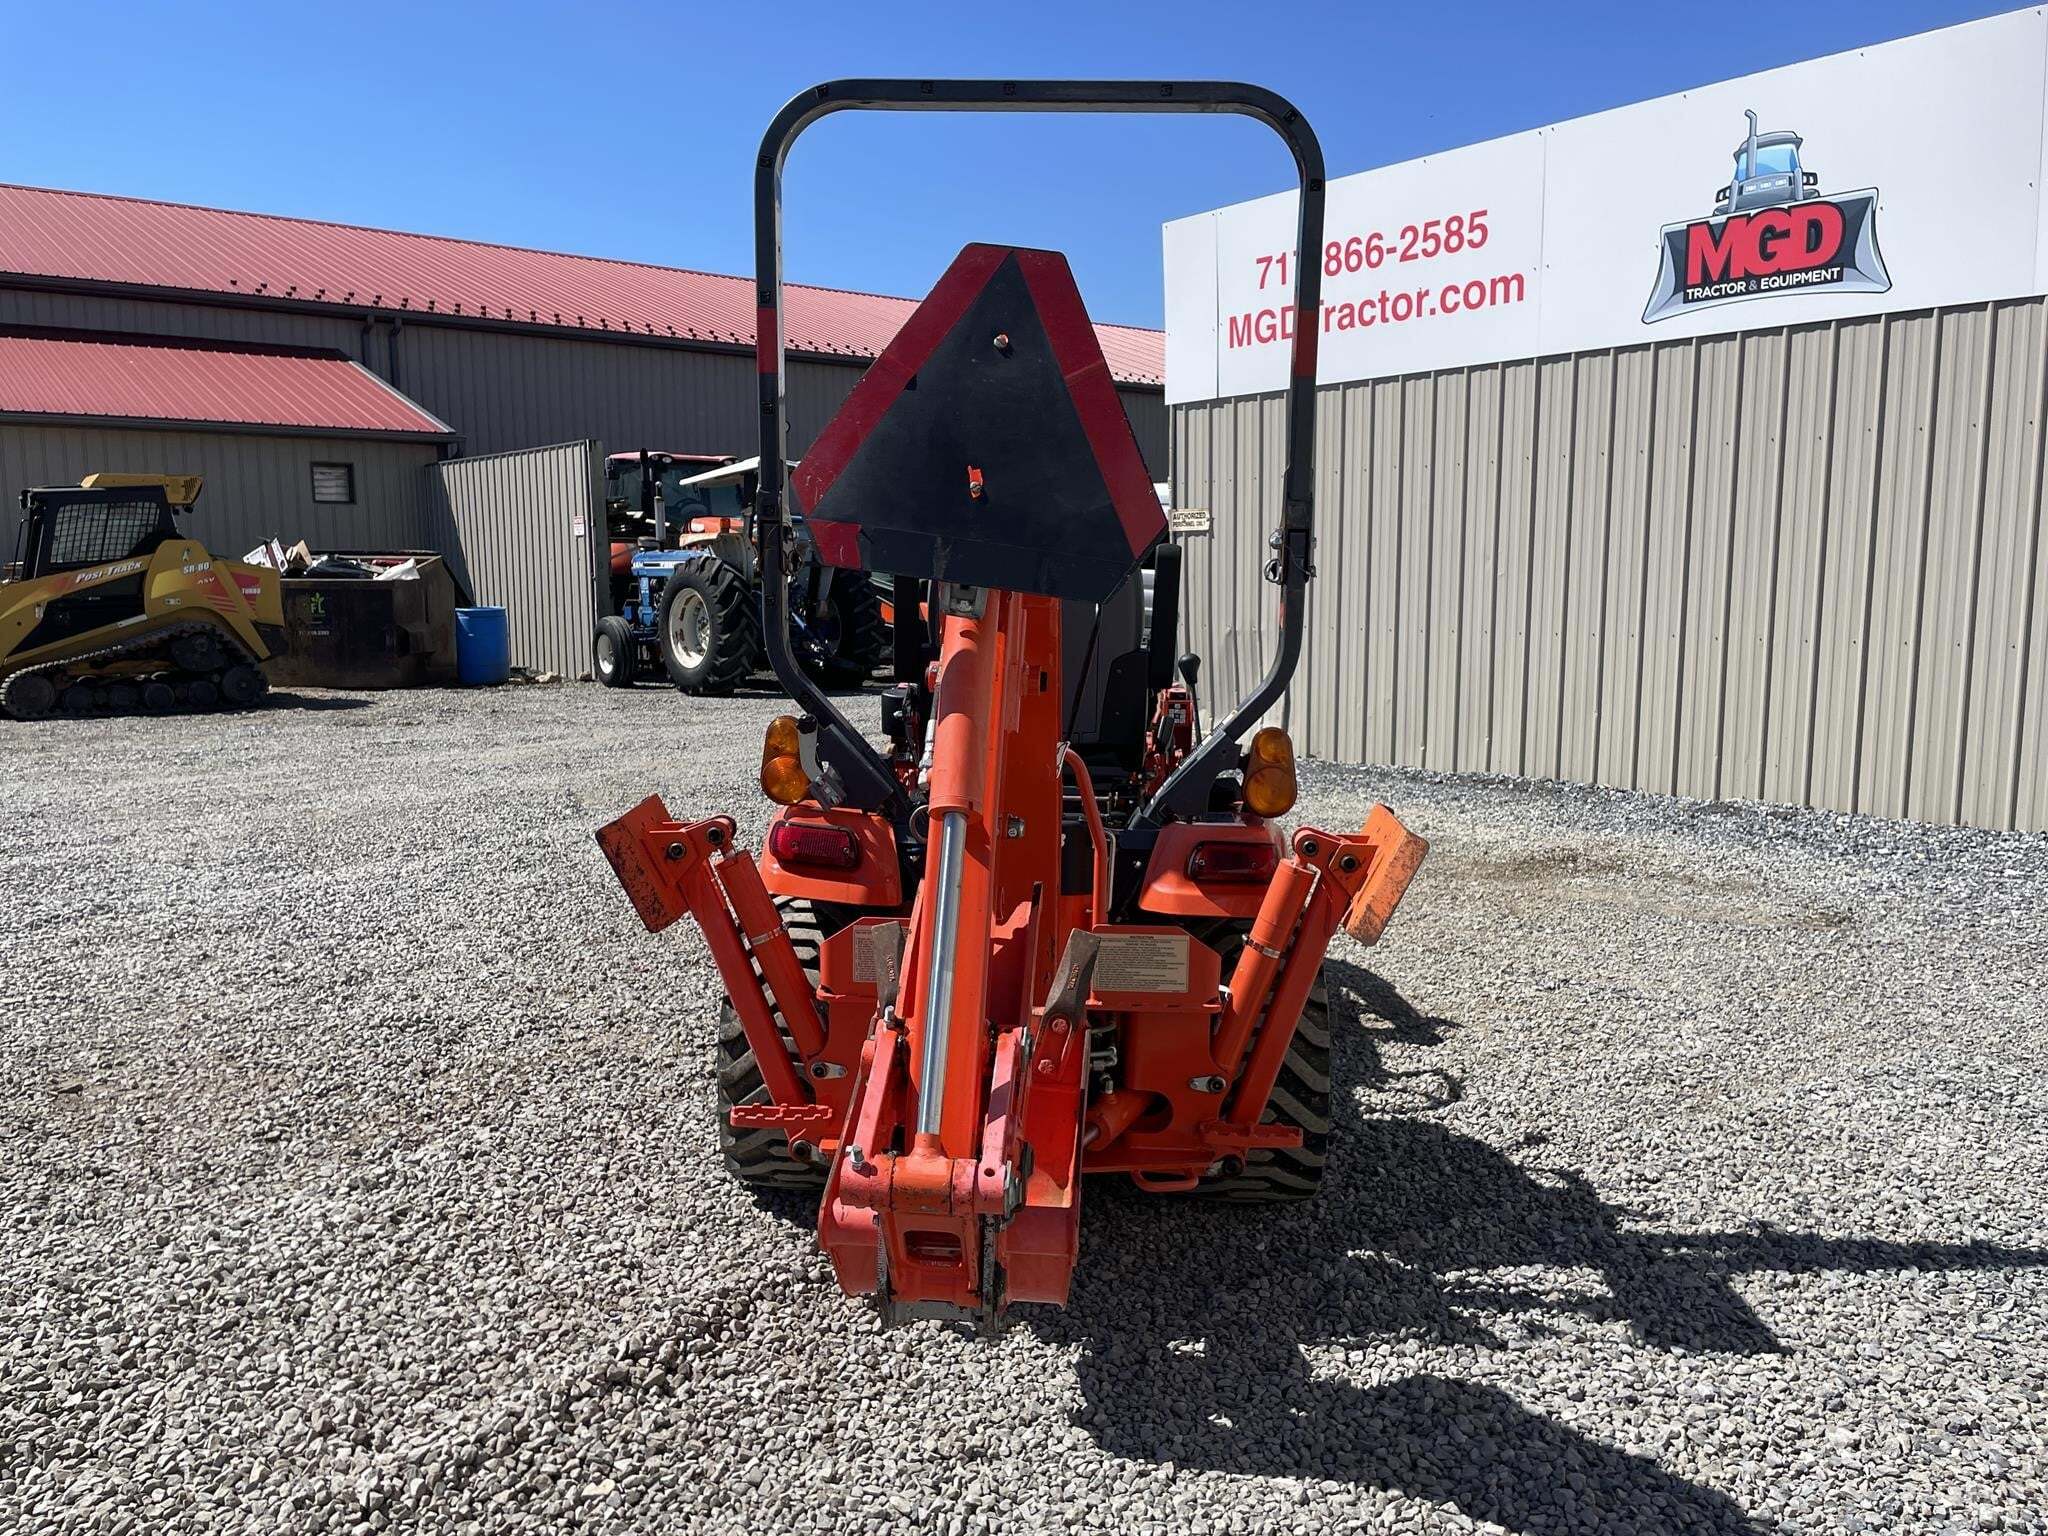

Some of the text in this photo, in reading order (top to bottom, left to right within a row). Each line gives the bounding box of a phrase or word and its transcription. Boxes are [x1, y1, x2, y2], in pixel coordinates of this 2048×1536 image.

[1255, 209, 1489, 290] 71866-2585
[1686, 202, 1844, 286] MGD
[1228, 273, 1526, 349] MGDractor.com
[1687, 267, 1841, 300] TRACTOR & EQUIPMENT
[1172, 511, 1206, 520] AUTHORIZED
